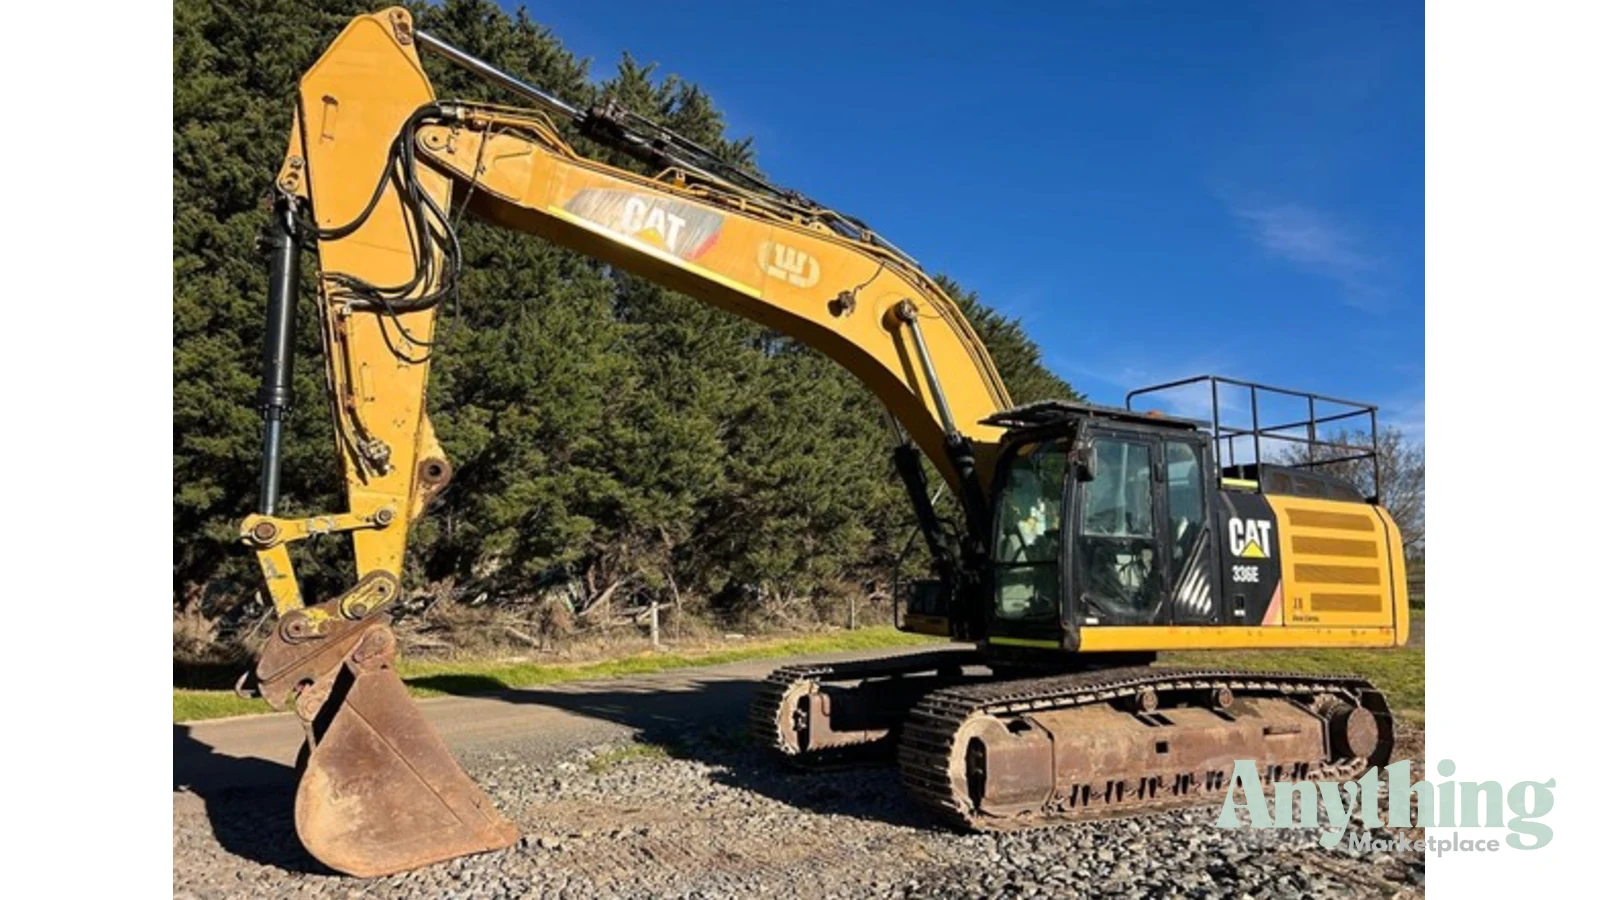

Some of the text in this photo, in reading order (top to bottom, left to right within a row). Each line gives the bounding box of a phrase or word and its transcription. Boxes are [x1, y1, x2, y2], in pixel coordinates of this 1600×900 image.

[621, 197, 685, 252] CAT
[1228, 517, 1271, 558] CAT
[1232, 565, 1259, 582] 336E
